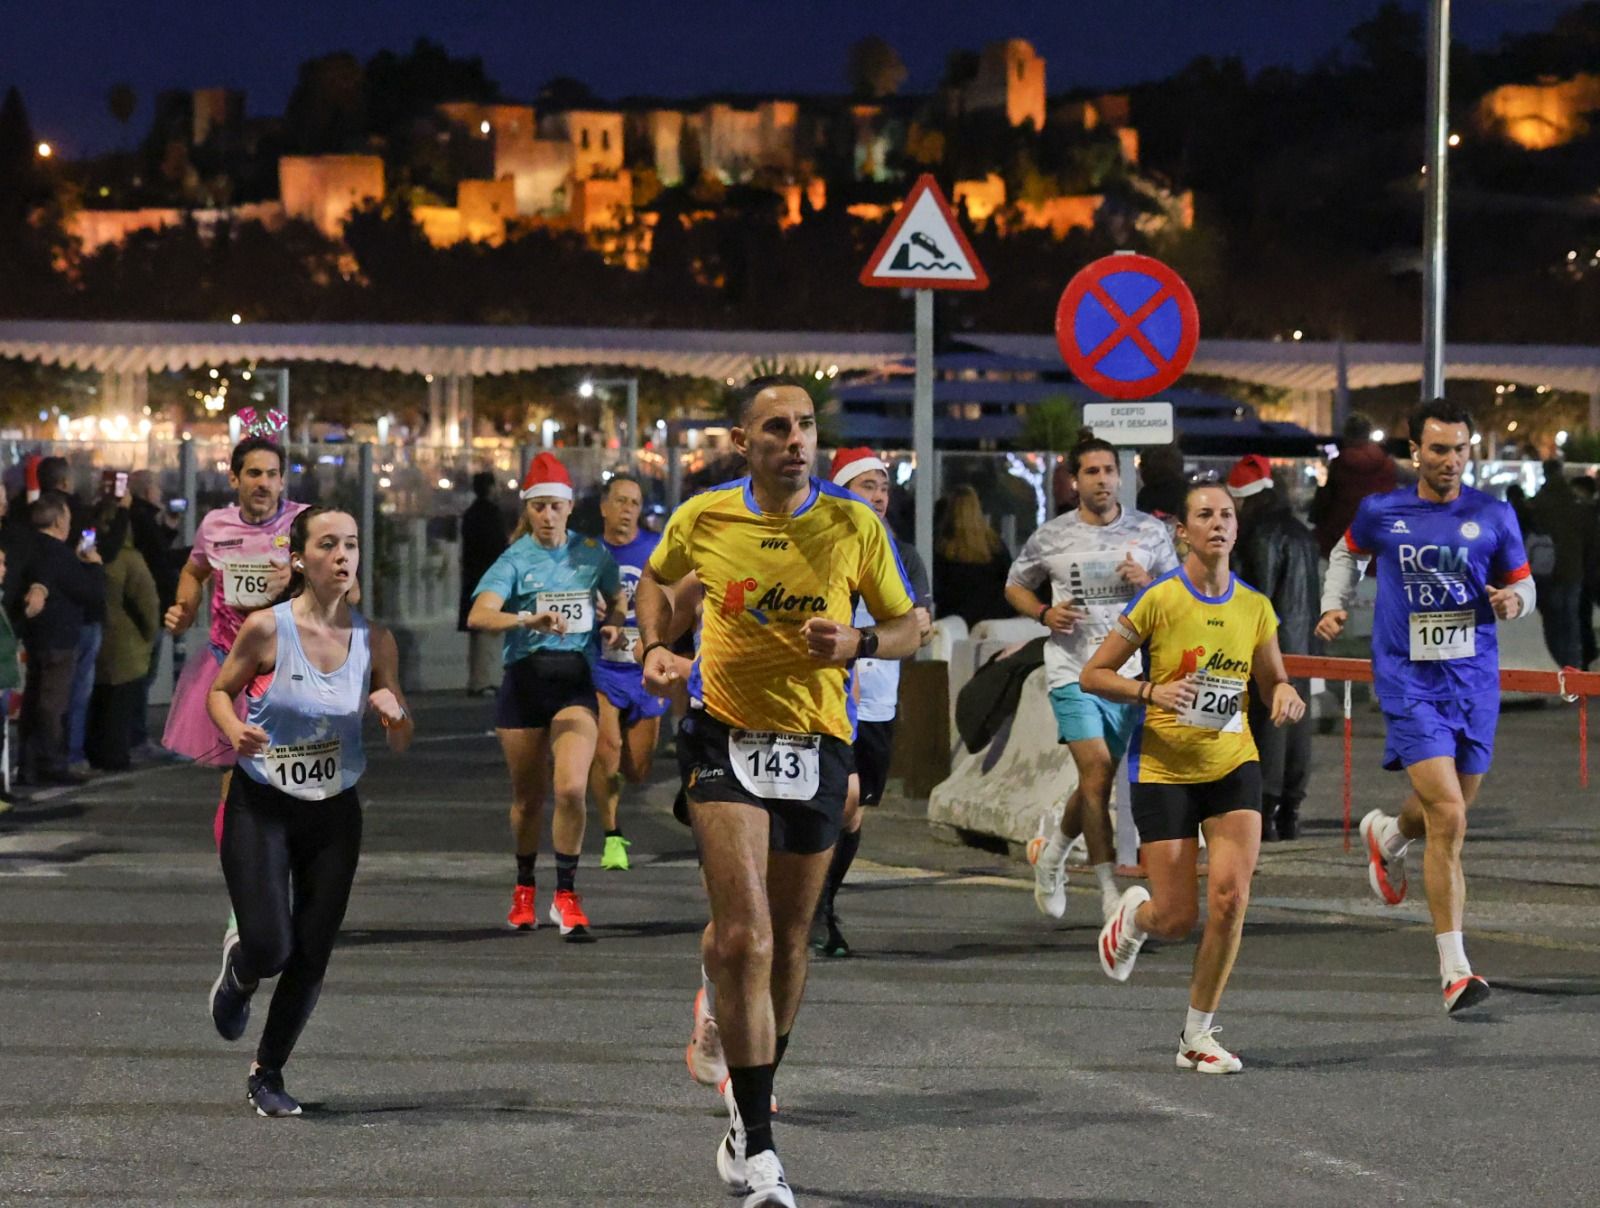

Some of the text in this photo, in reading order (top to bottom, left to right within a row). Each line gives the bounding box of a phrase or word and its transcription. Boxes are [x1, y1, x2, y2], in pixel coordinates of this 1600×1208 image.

[1088, 419, 1168, 428] CARGA Y DESCARGA
[1110, 407, 1146, 416] EXCEPTO
[761, 538, 789, 550] vive
[1398, 544, 1469, 573] RCM
[234, 575, 268, 593] 769
[1403, 582, 1468, 606] 1873
[756, 582, 828, 612] Álora
[1418, 623, 1468, 646] 1071
[1204, 648, 1248, 673] Álora
[1191, 690, 1239, 716] 1206
[275, 756, 336, 786] 1040
[747, 749, 800, 779] 143
